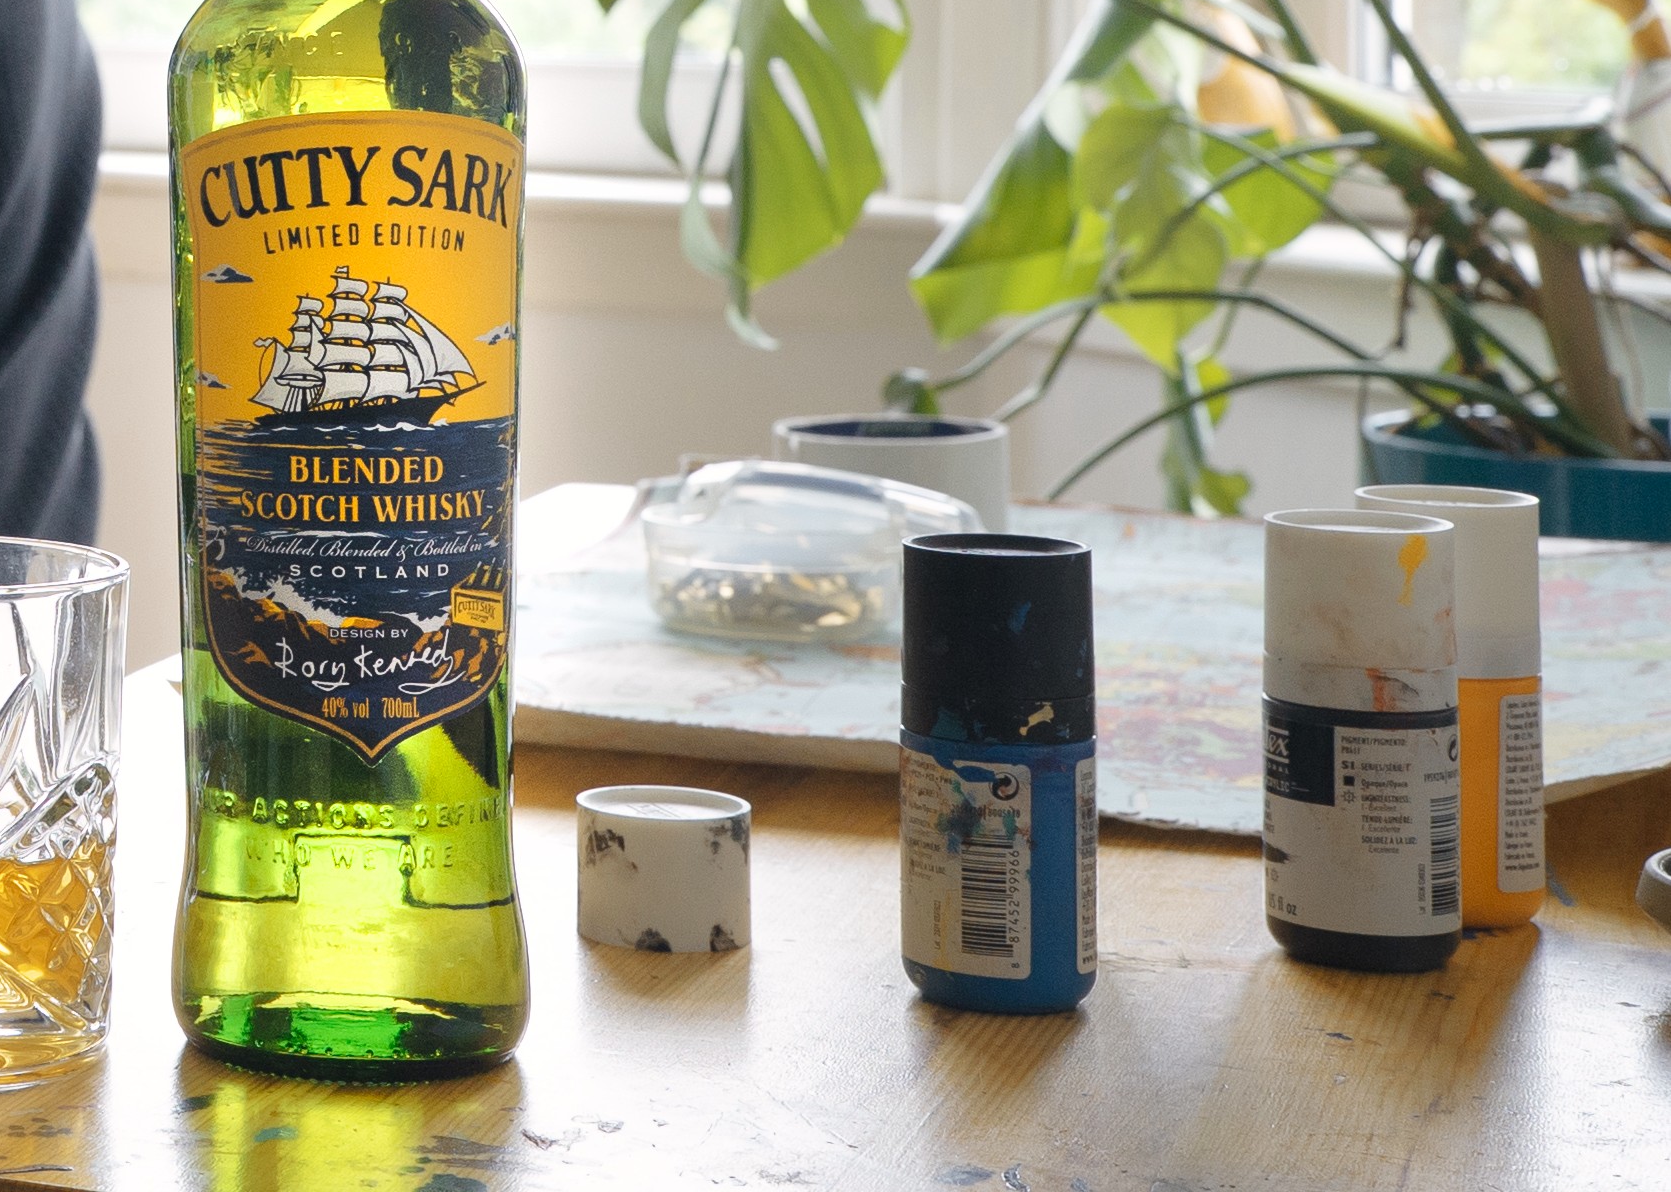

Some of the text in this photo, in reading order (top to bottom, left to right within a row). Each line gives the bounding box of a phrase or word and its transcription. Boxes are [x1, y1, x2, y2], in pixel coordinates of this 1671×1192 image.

[200, 145, 513, 229] CUTTY SARK
[263, 222, 465, 255] LIMITED EDITION
[290, 455, 444, 485] BLENDED
[241, 490, 485, 523] SCOTCH WHISKY
[319, 536, 391, 559] Blended
[396, 540, 409, 563] &
[415, 533, 467, 558] Bottled
[289, 563, 450, 580] SCOTLAND
[329, 628, 409, 639] DESIGN BY
[322, 699, 349, 719] 40%
[352, 699, 370, 719] vol
[252, 796, 394, 830] ACTIONS
[397, 842, 455, 876] ARE
